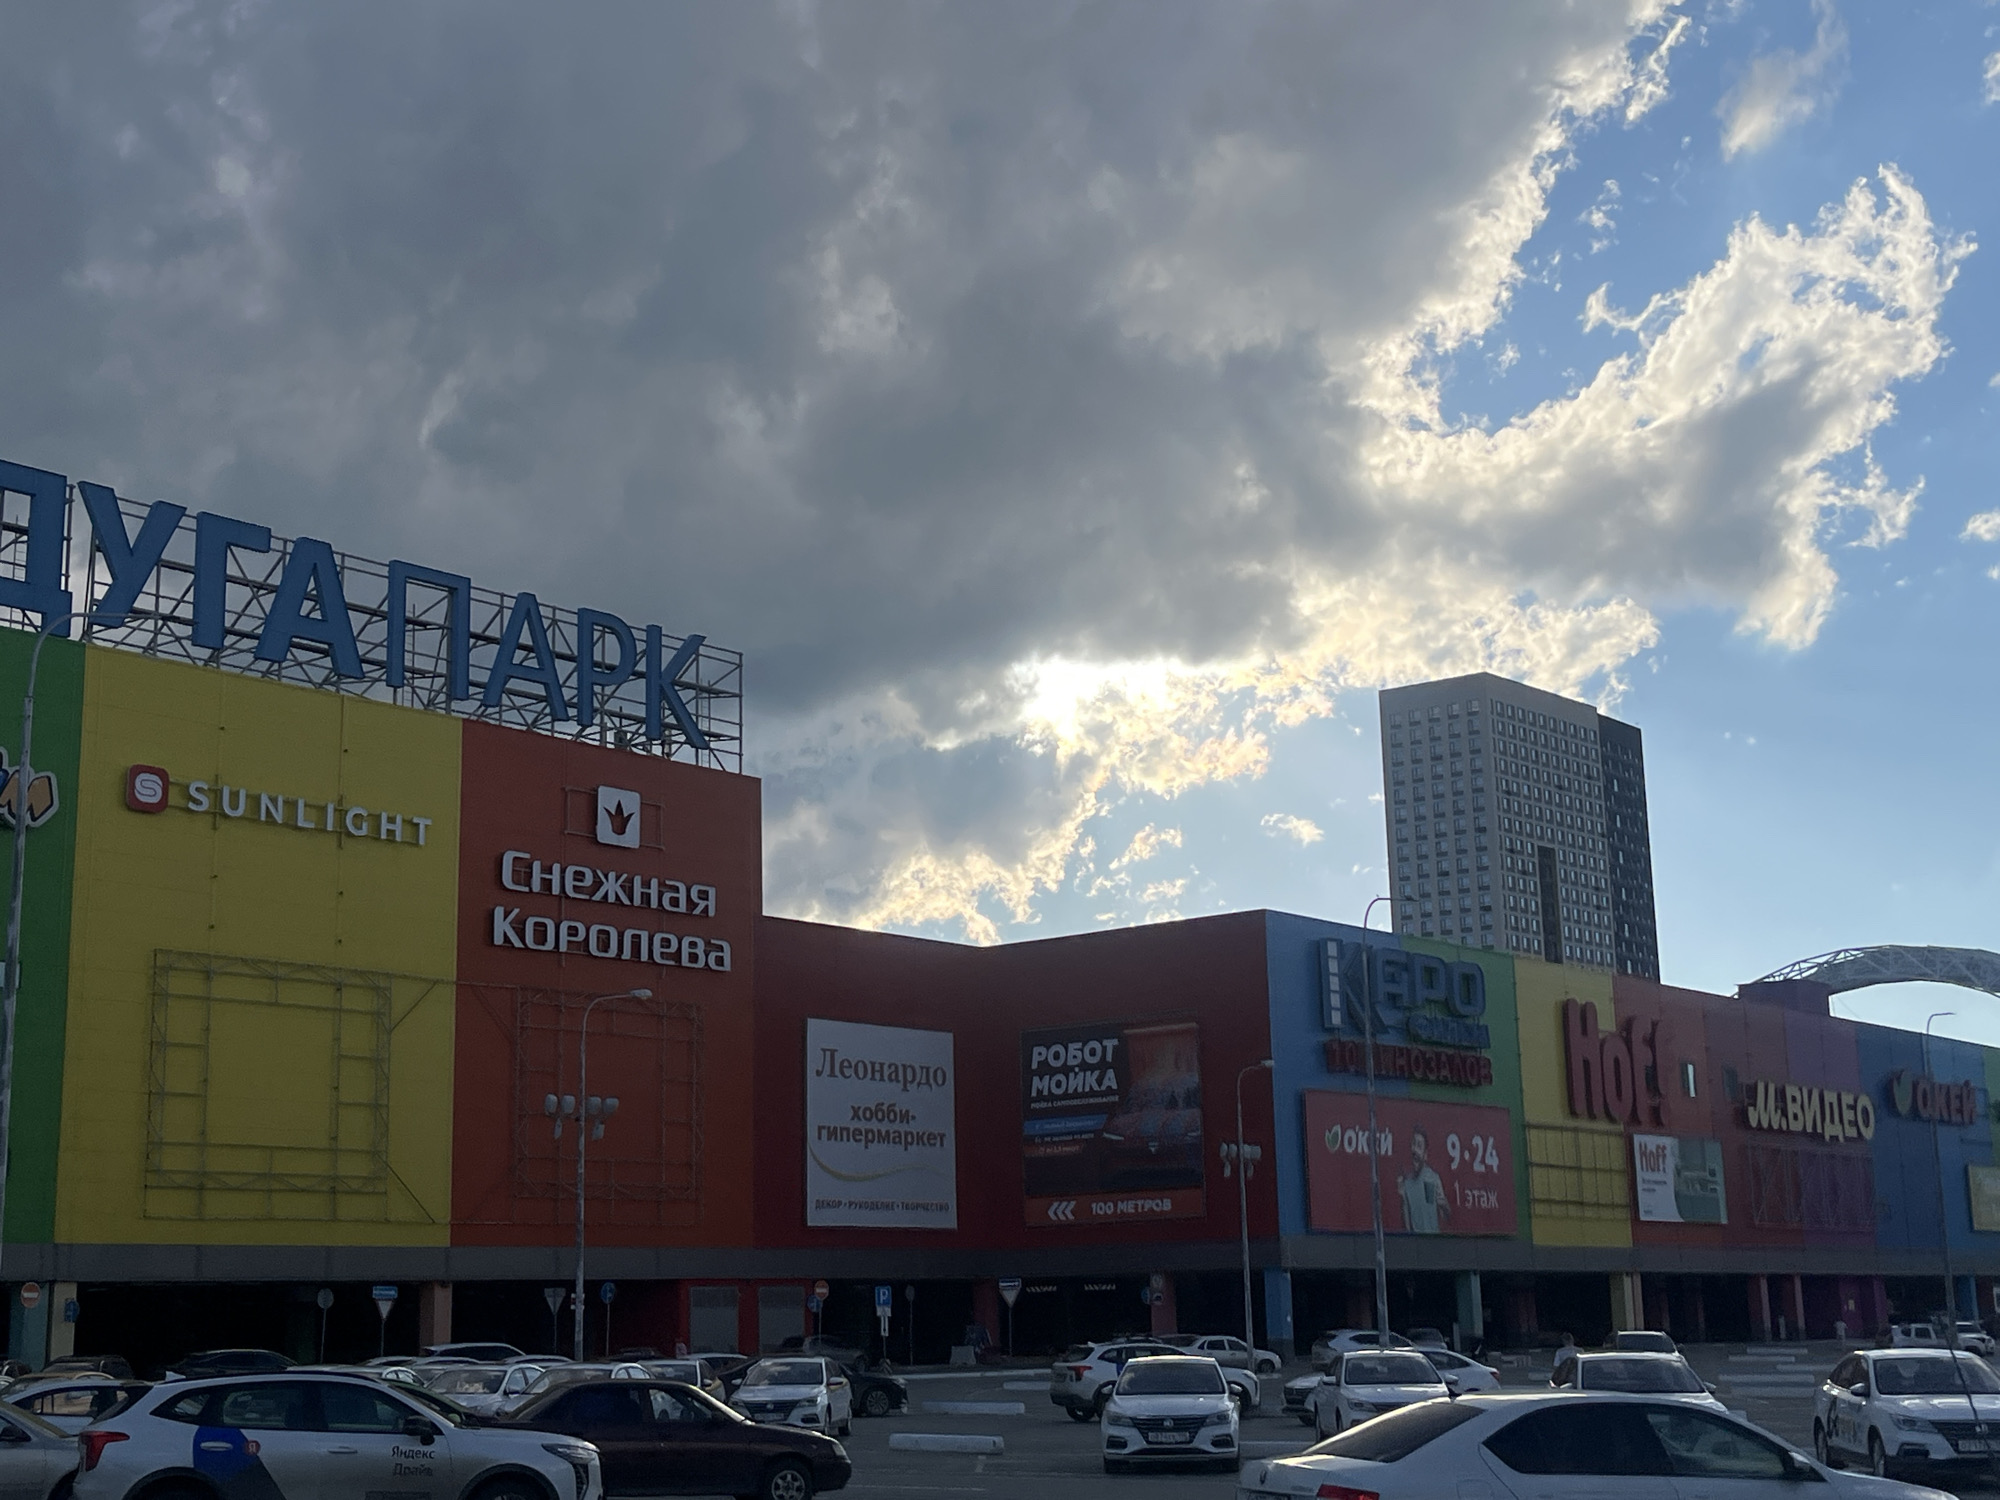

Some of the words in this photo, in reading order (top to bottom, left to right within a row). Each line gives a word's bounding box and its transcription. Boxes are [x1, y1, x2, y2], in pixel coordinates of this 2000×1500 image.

[187, 780, 433, 846] SUNLIGHT
[501, 849, 717, 917] Снежная
[493, 905, 732, 972] Королева
[815, 1047, 947, 1091] Леонардо
[1030, 1038, 1119, 1070] РОБОТ
[1364, 1043, 1492, 1085] ИНОЗАЛОВ
[1563, 998, 1669, 1127] Hoff
[1030, 1067, 1118, 1098] МОЙКА
[1748, 1079, 1875, 1143] М.ВИДЕО
[817, 1124, 946, 1151] гипермаркет
[1639, 1141, 1667, 1173] Hoff
[815, 1198, 843, 1210] ДЕКОР
[1091, 1201, 1114, 1215] 100
[1116, 1198, 1172, 1214] МЕТРОВ
[1454, 1181, 1462, 1208] 1
[1465, 1188, 1499, 1209] этаж
[391, 1445, 436, 1460] Яндекс
